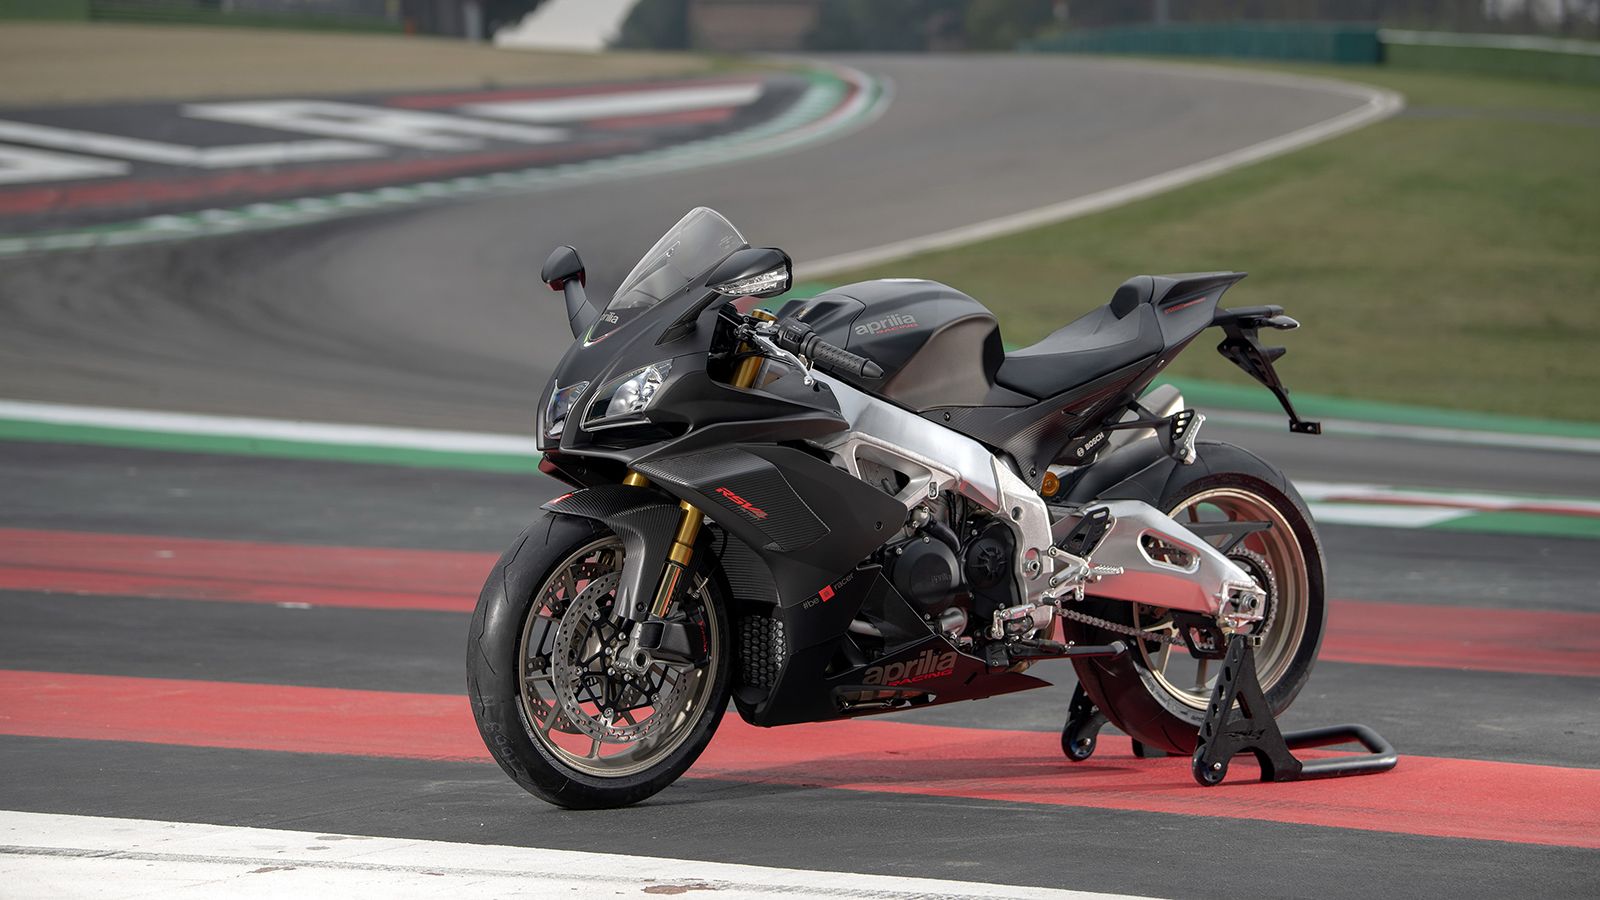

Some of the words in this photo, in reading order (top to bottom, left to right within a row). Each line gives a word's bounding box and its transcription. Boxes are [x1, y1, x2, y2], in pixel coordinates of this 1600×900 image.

[854, 314, 917, 335] aprilia
[1084, 431, 1105, 450] BOSCH
[802, 597, 820, 609] #be
[834, 573, 854, 590] racer
[862, 649, 958, 686] aprilia
[887, 668, 953, 687] RACING
